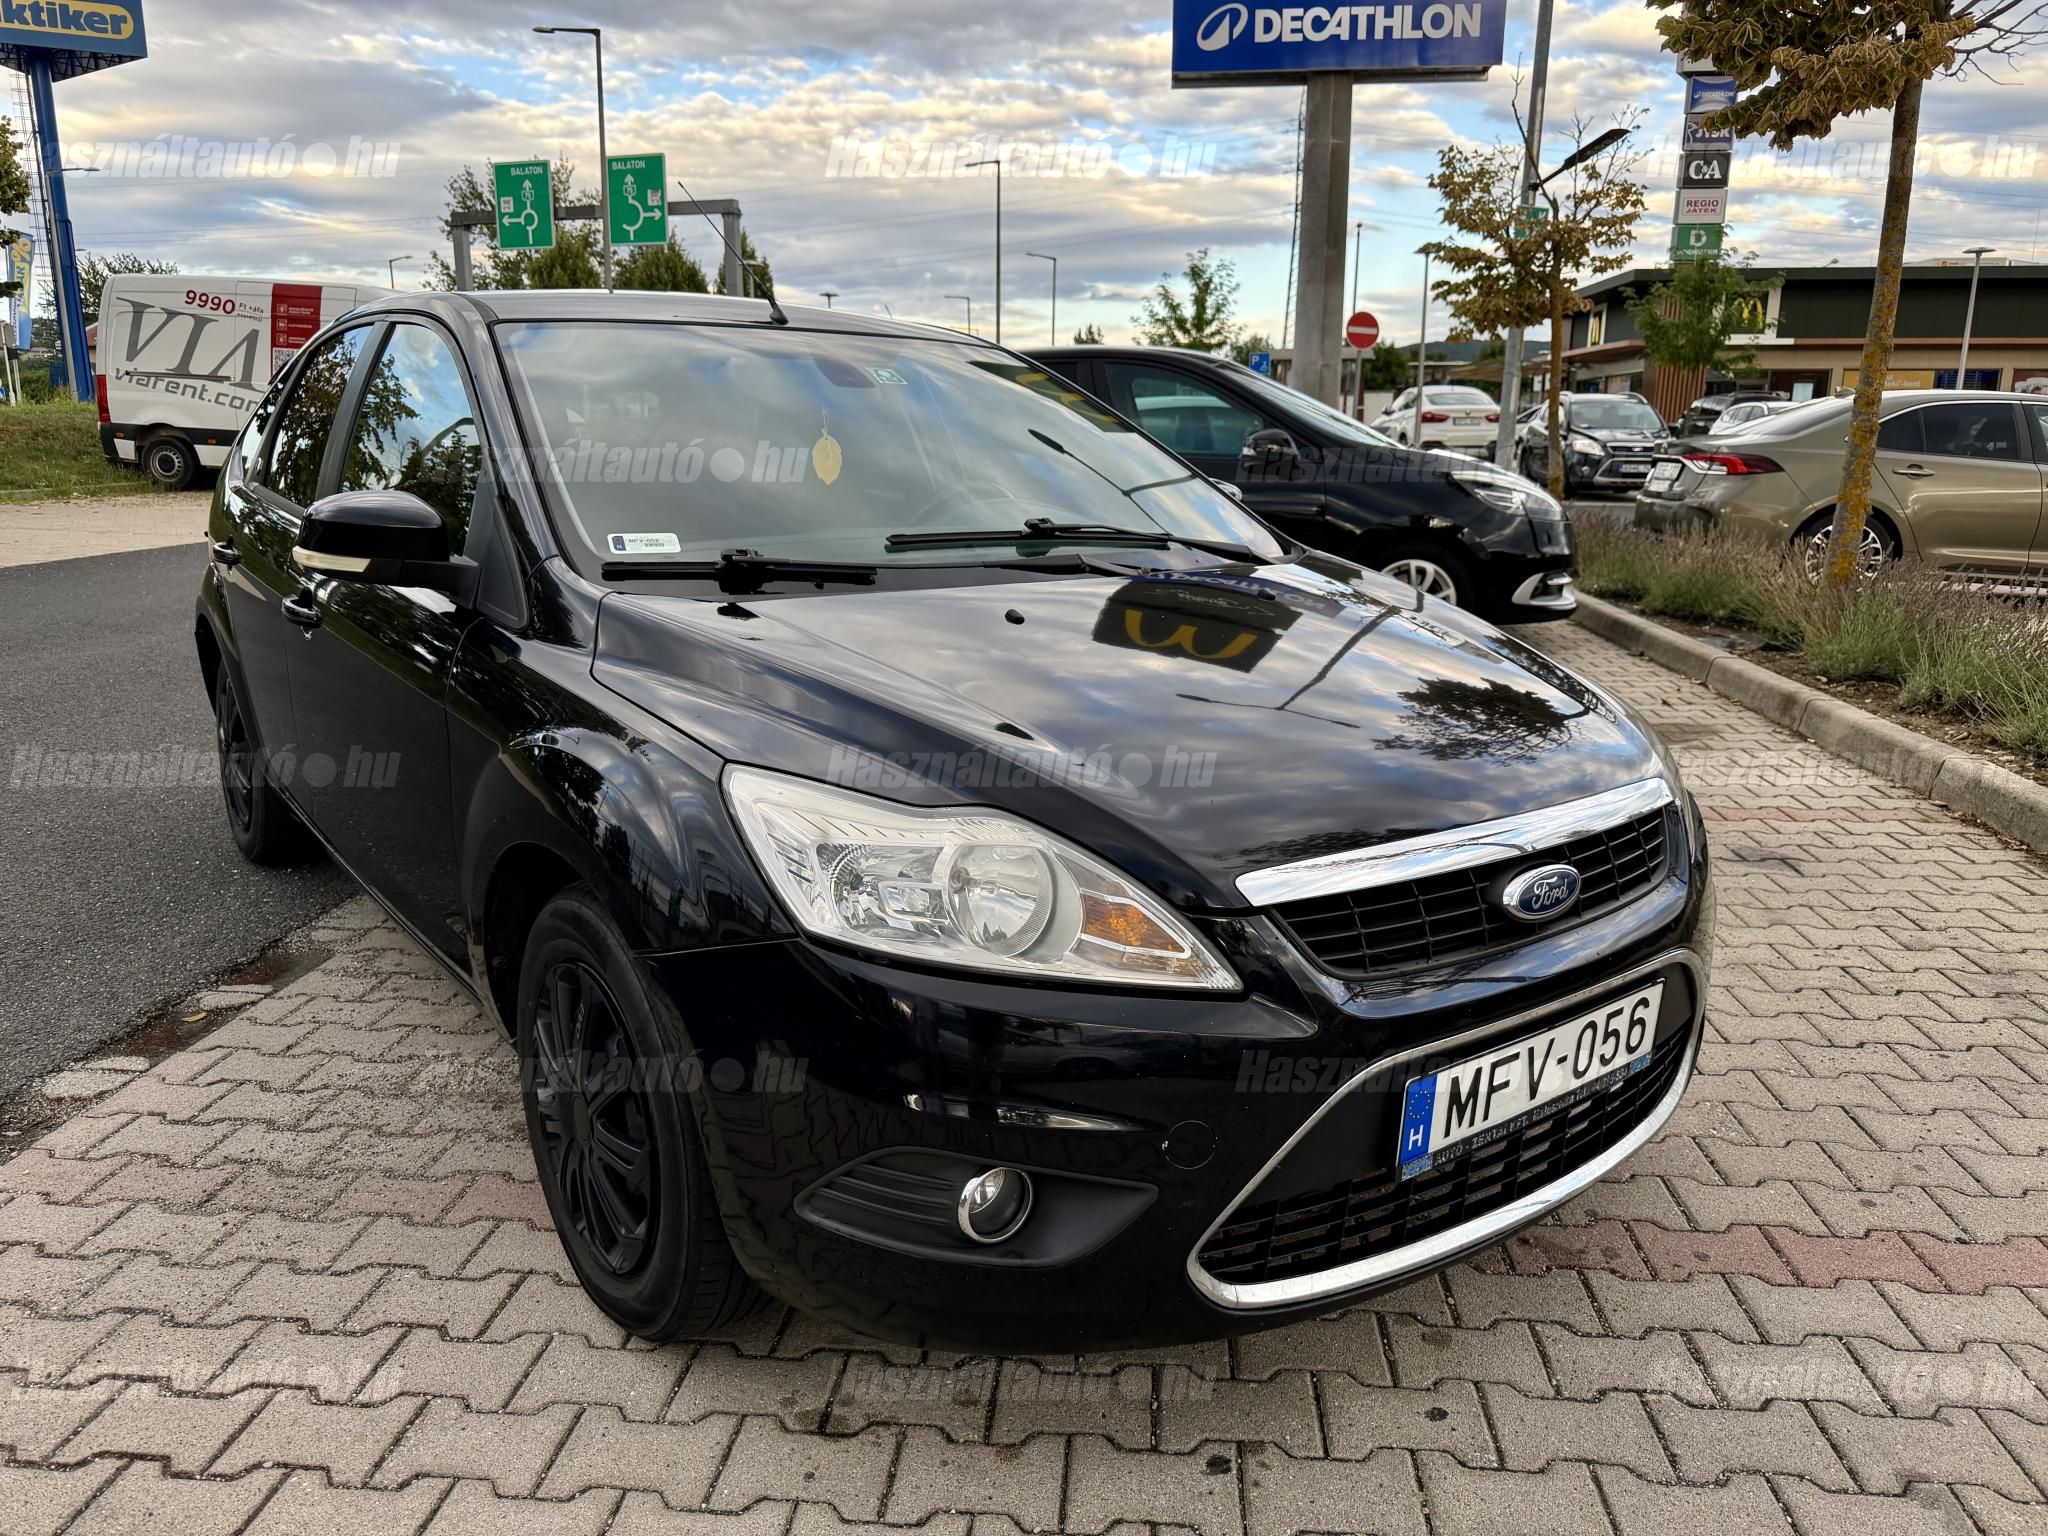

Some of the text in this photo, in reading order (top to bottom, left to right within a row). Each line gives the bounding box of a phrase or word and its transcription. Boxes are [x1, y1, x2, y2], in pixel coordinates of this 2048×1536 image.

[1254, 3, 1481, 43] DECATHLON
[511, 166, 543, 176] BALATON
[612, 160, 646, 170] BALATON
[1689, 160, 1722, 179] C&A
[185, 290, 236, 315] 9990
[116, 297, 265, 393] VIA
[1531, 876, 1569, 909] Ford
[1444, 996, 1650, 1138] MFV-056
[1408, 1124, 1424, 1150] H
